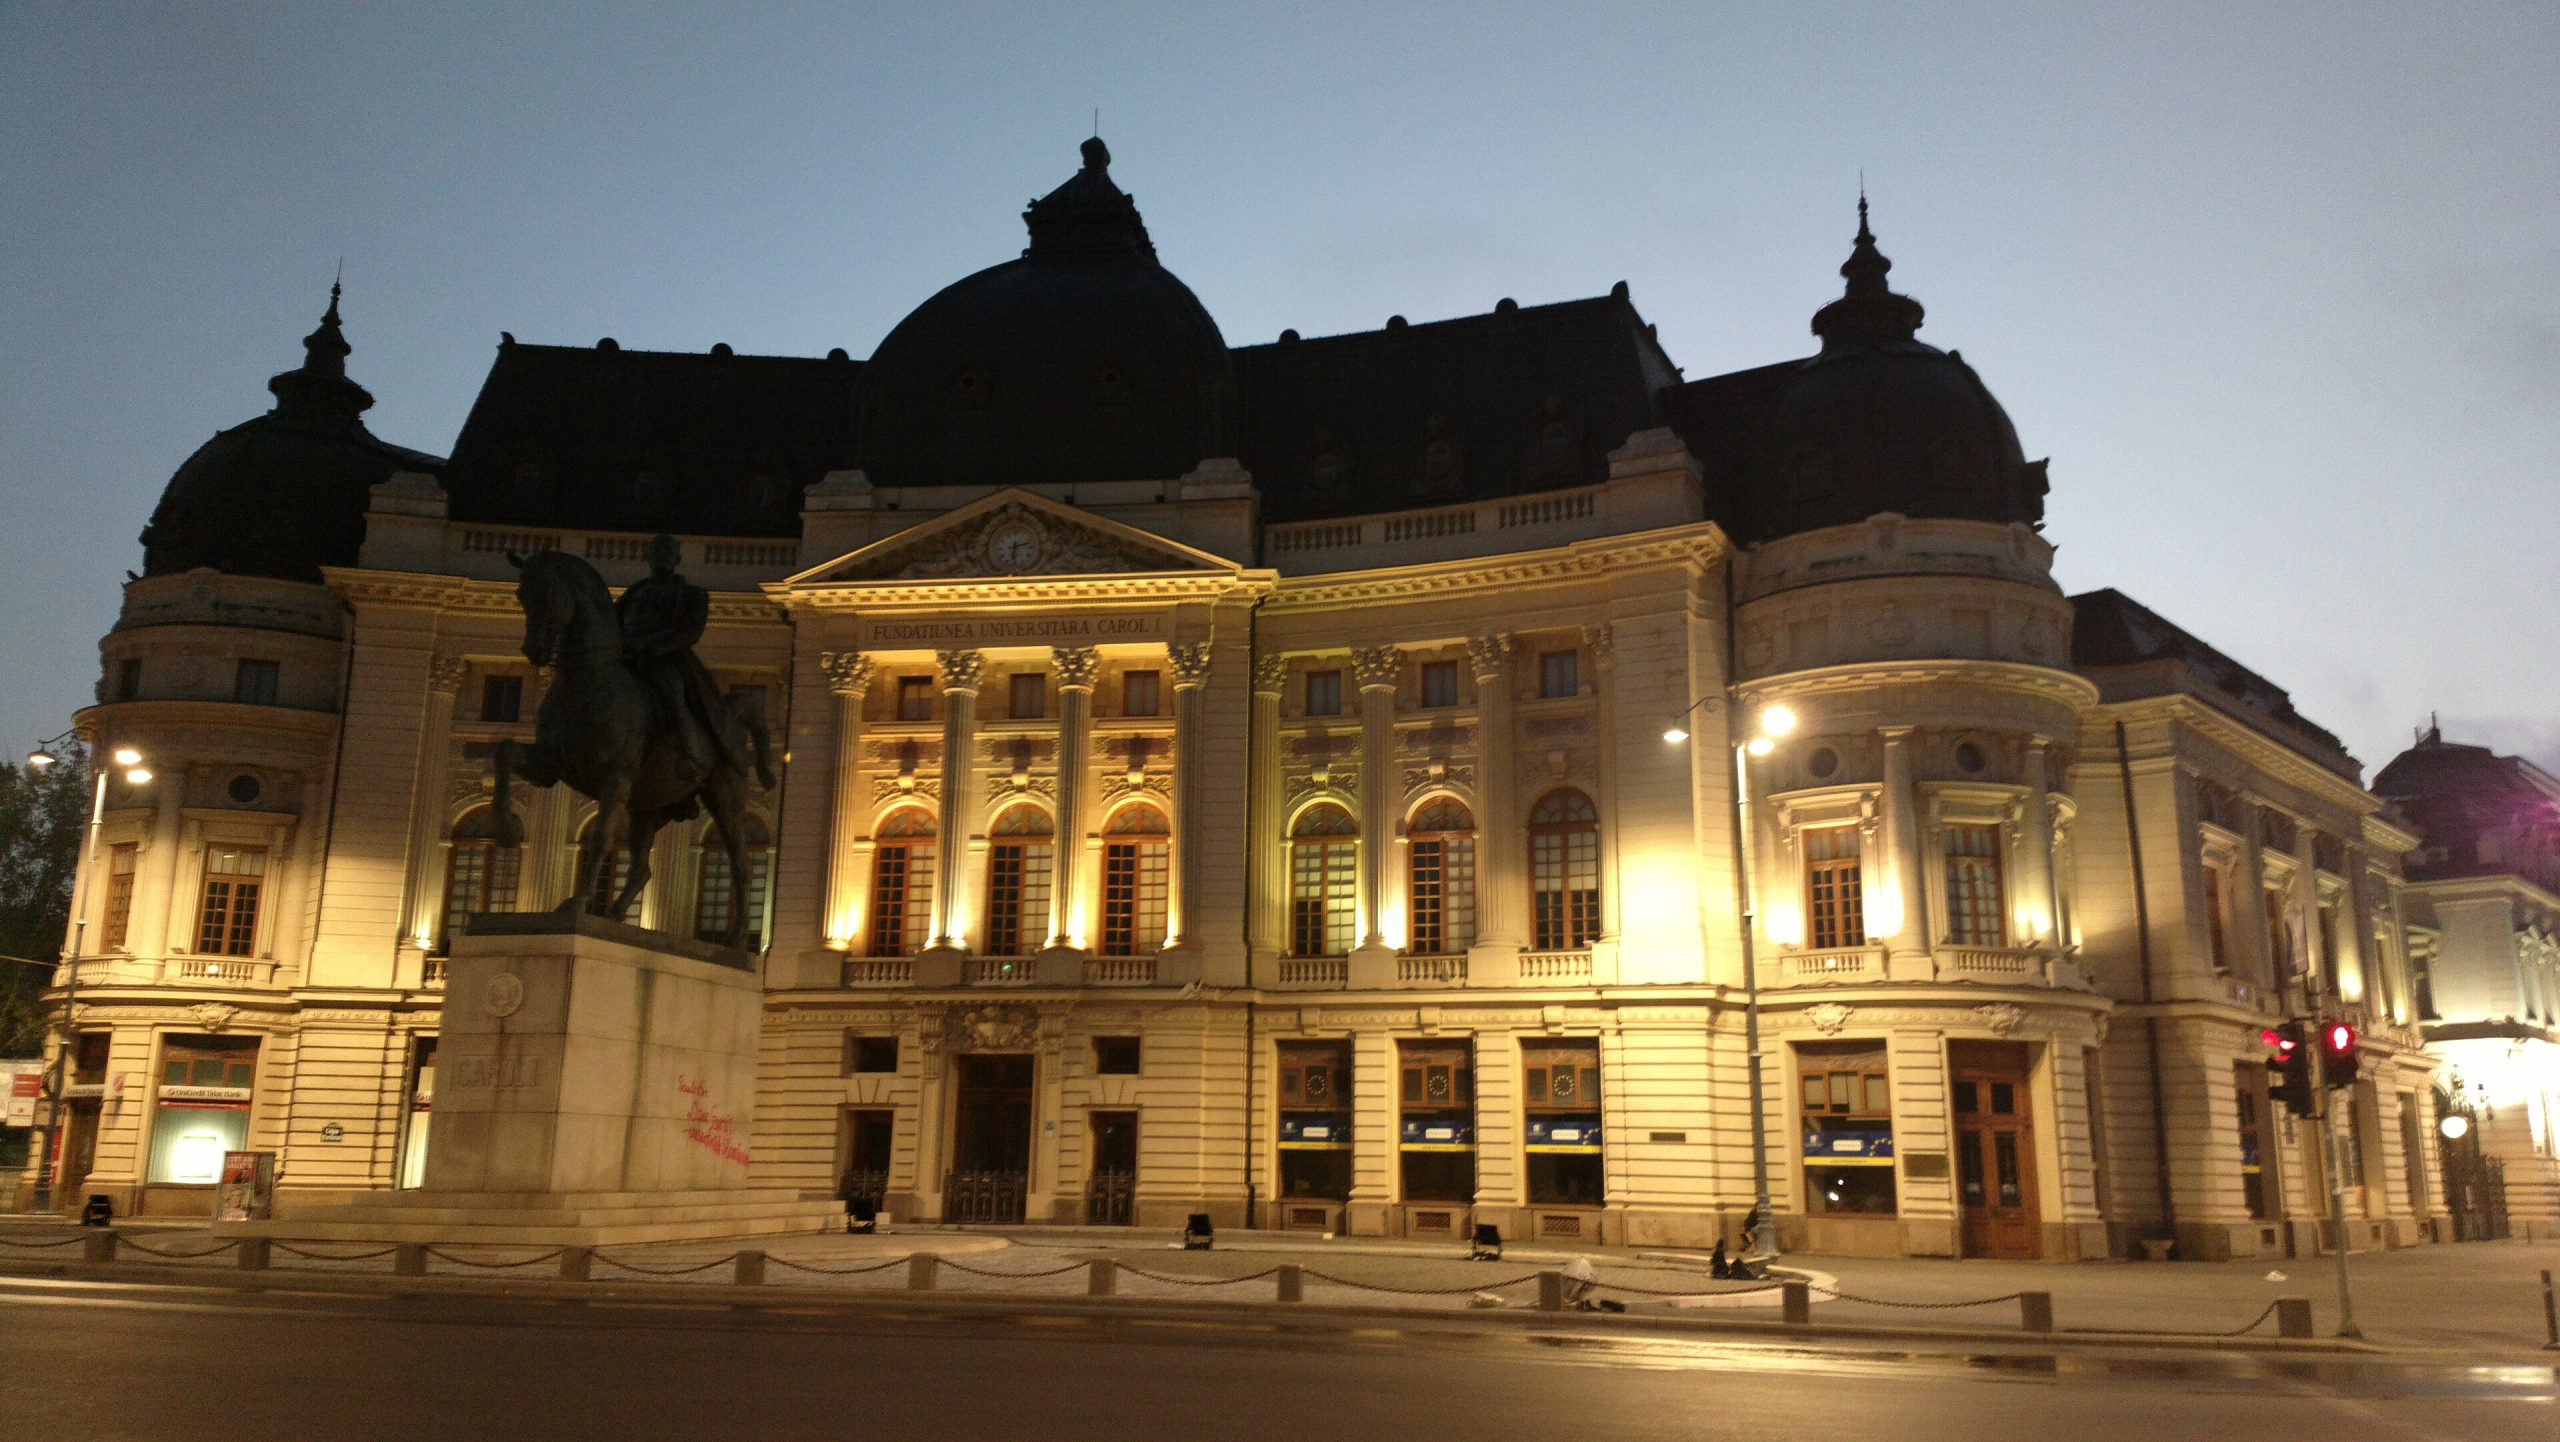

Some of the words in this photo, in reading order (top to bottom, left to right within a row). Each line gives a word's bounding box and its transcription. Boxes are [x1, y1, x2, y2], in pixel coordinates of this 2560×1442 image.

[981, 621, 1090, 637] UNIVERSITARA
[1098, 618, 1149, 633] CAROL
[1155, 617, 1161, 631] I
[176, 1089, 205, 1097] UniCredit
